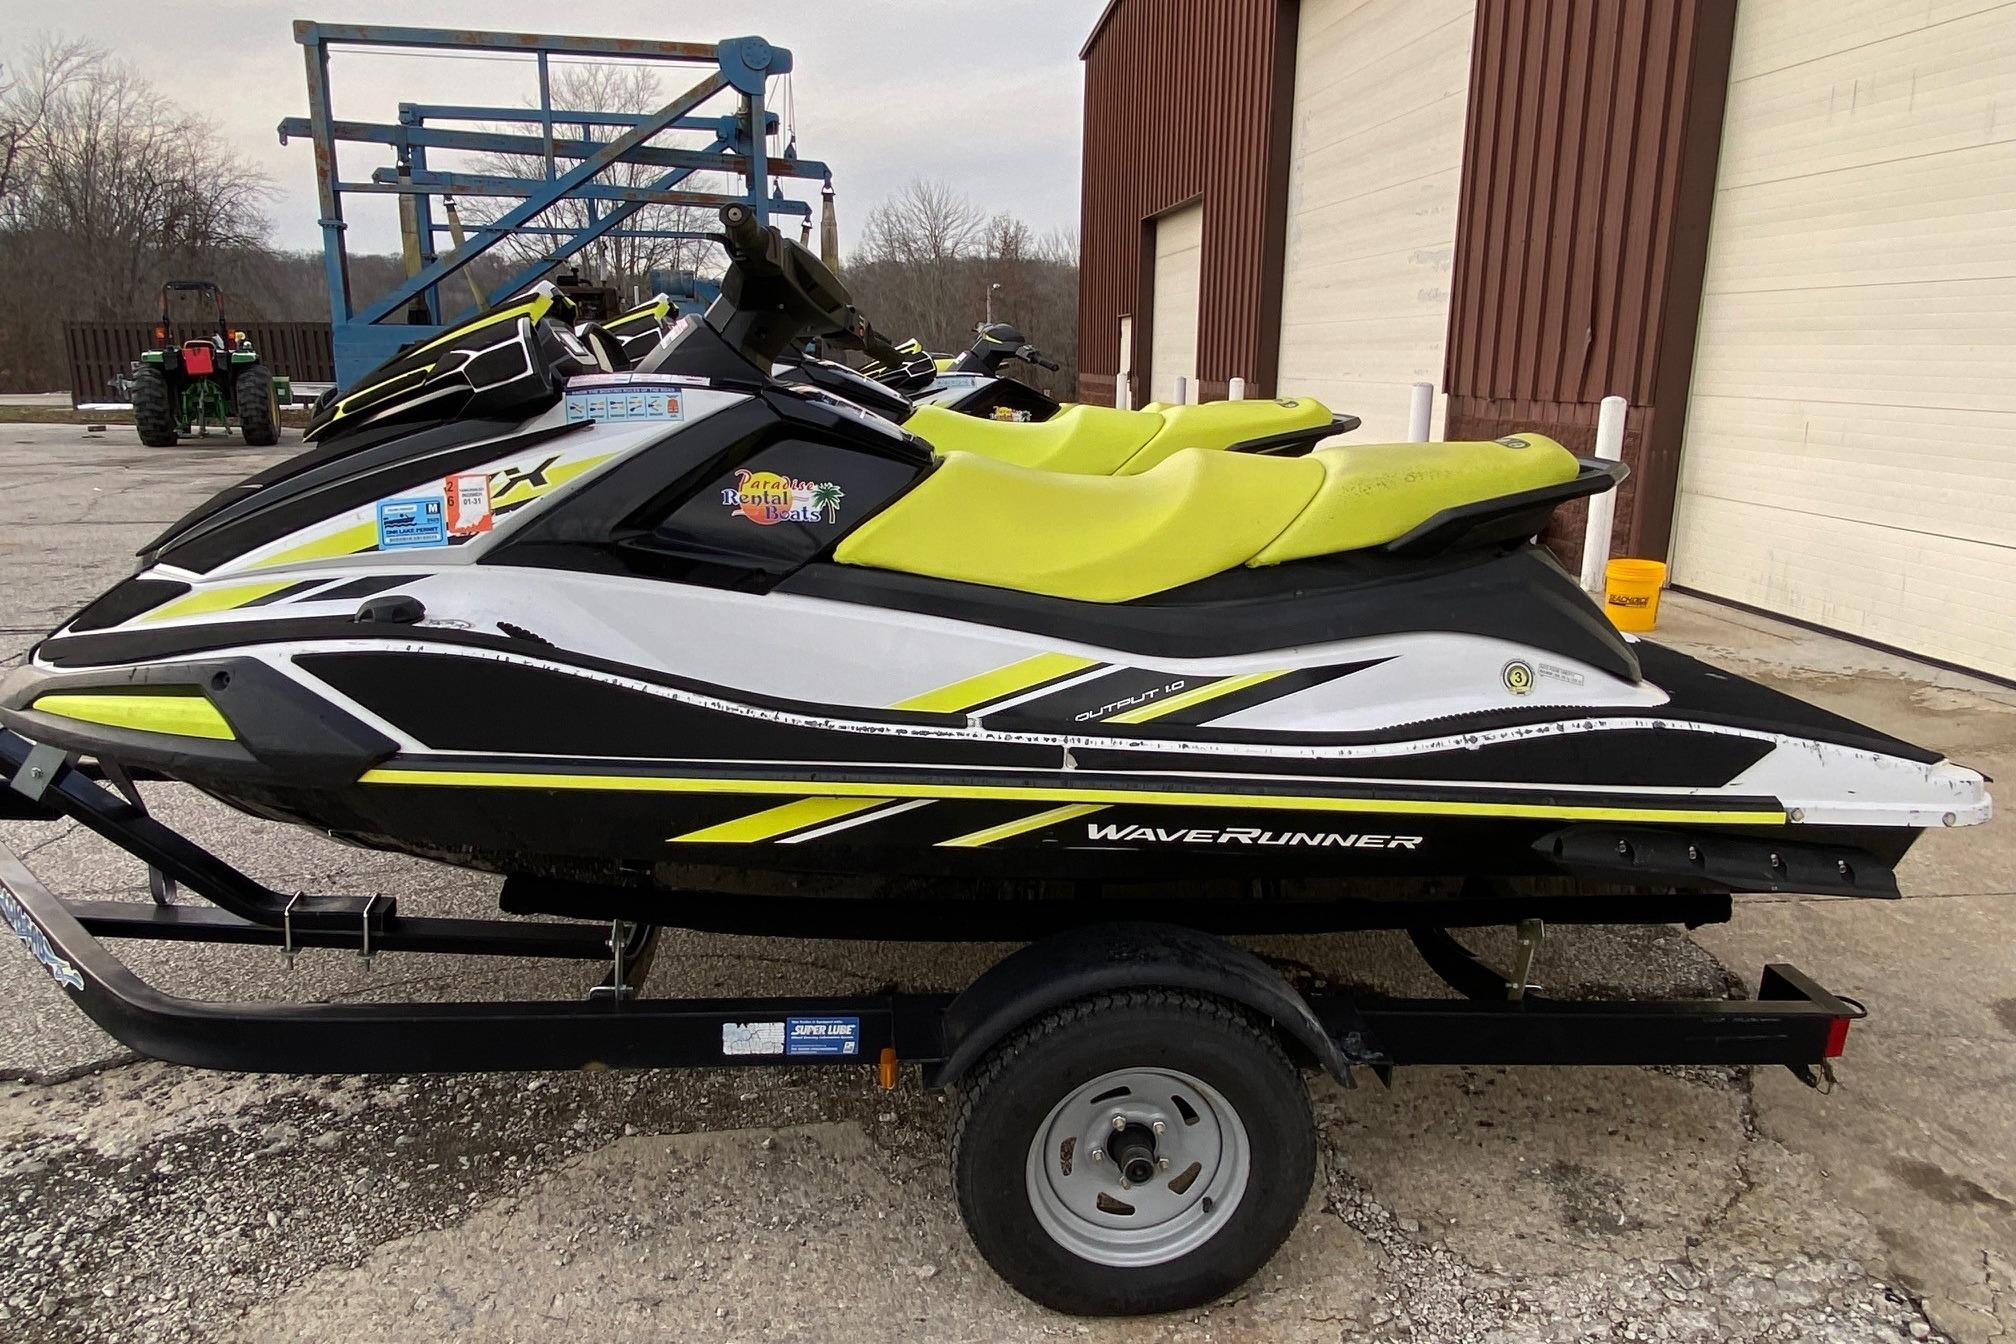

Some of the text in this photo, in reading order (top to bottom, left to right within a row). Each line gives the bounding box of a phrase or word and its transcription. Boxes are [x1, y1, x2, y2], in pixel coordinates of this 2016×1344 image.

[734, 468, 816, 493] Paradise
[721, 488, 789, 507] Rental
[427, 503, 438, 513] M
[765, 505, 822, 522] Boats
[1514, 671, 1523, 684] 3
[1074, 680, 1185, 722] OUTPUT 1.0
[790, 1024, 855, 1036] SUPER LUBE
